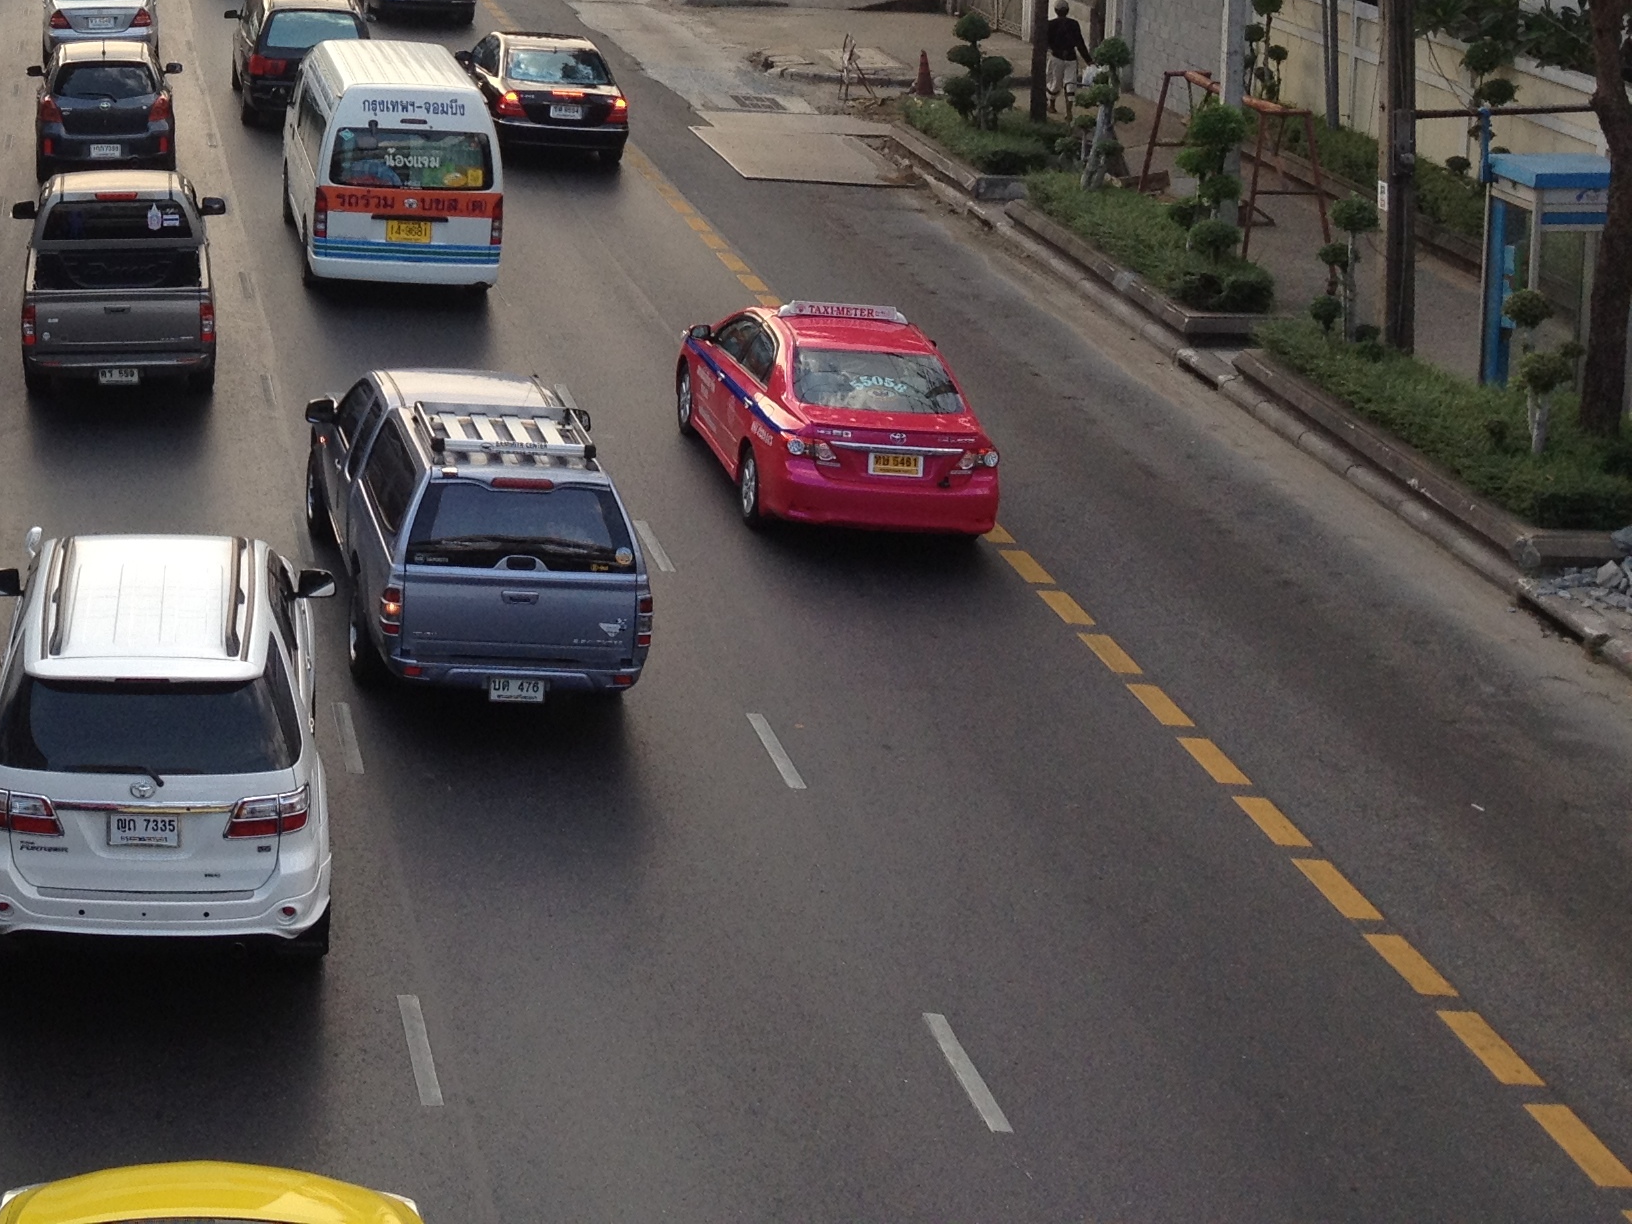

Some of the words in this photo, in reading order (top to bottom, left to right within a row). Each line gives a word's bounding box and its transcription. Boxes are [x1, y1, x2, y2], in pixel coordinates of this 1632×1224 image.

[362, 98, 466, 117] กรุงเทพฯ-จอมบึง
[335, 189, 395, 209] รถร่วม
[517, 681, 540, 693] 476
[143, 818, 176, 833] 7335
